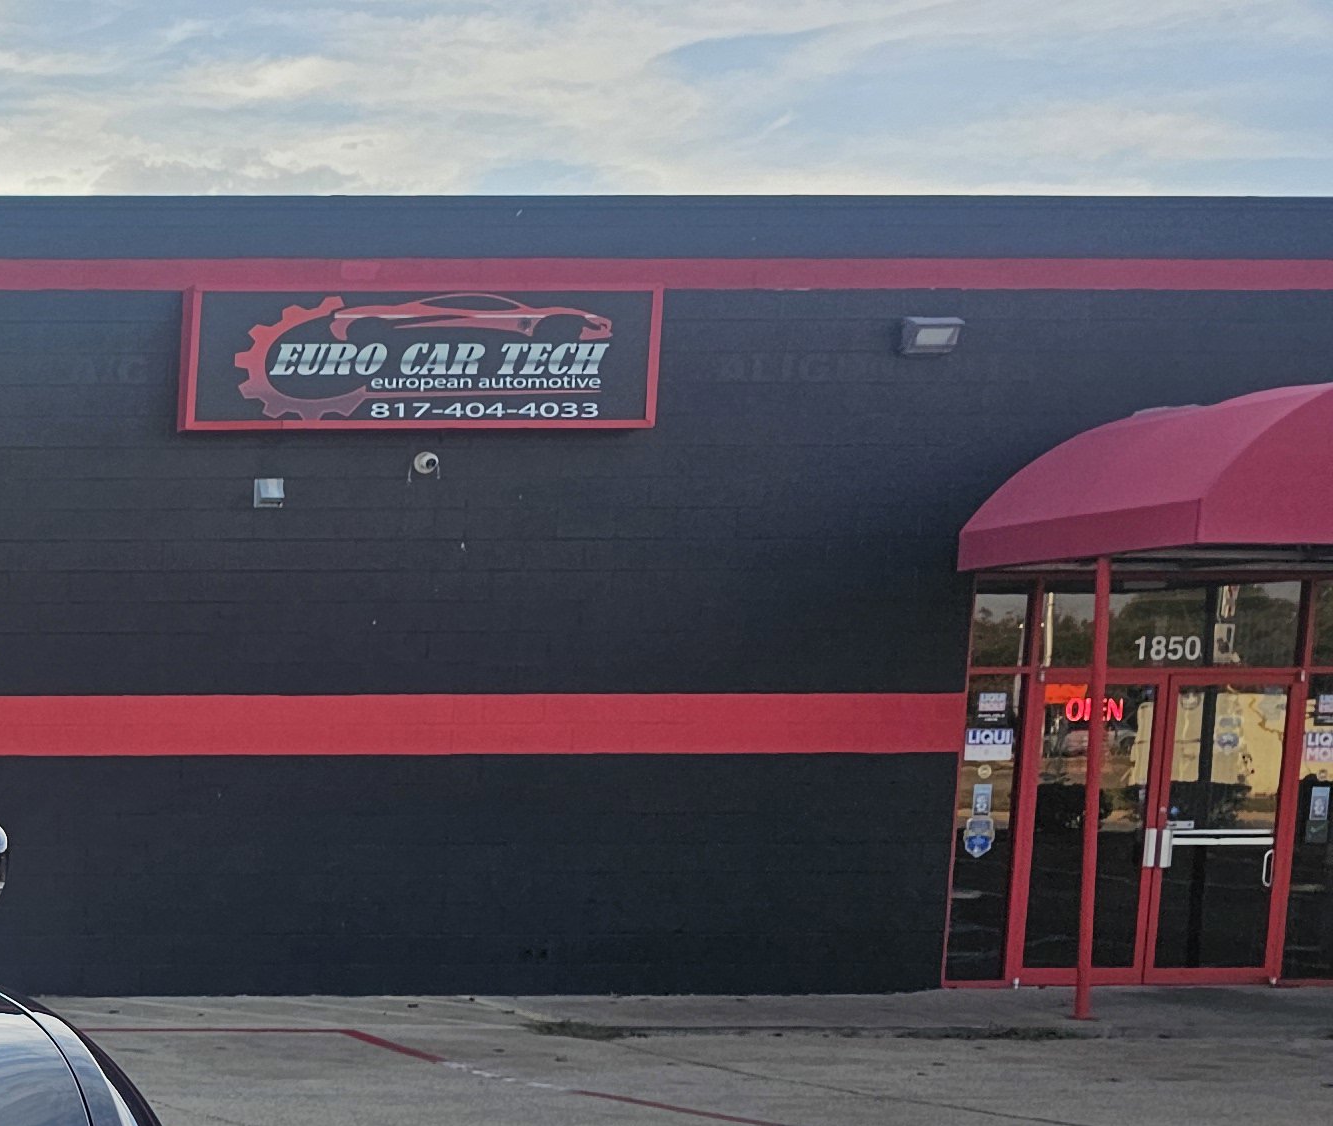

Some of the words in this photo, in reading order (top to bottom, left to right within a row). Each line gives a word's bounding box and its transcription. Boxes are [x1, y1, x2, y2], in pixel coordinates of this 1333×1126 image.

[269, 343, 387, 375] EURO
[399, 343, 485, 375] CAR
[497, 343, 609, 375] TECH
[370, 376, 472, 391] european
[479, 375, 601, 389] automotive
[370, 402, 599, 418] 817-404-4033
[1135, 635, 1201, 660] 1850
[968, 729, 1011, 744] LIQUI
